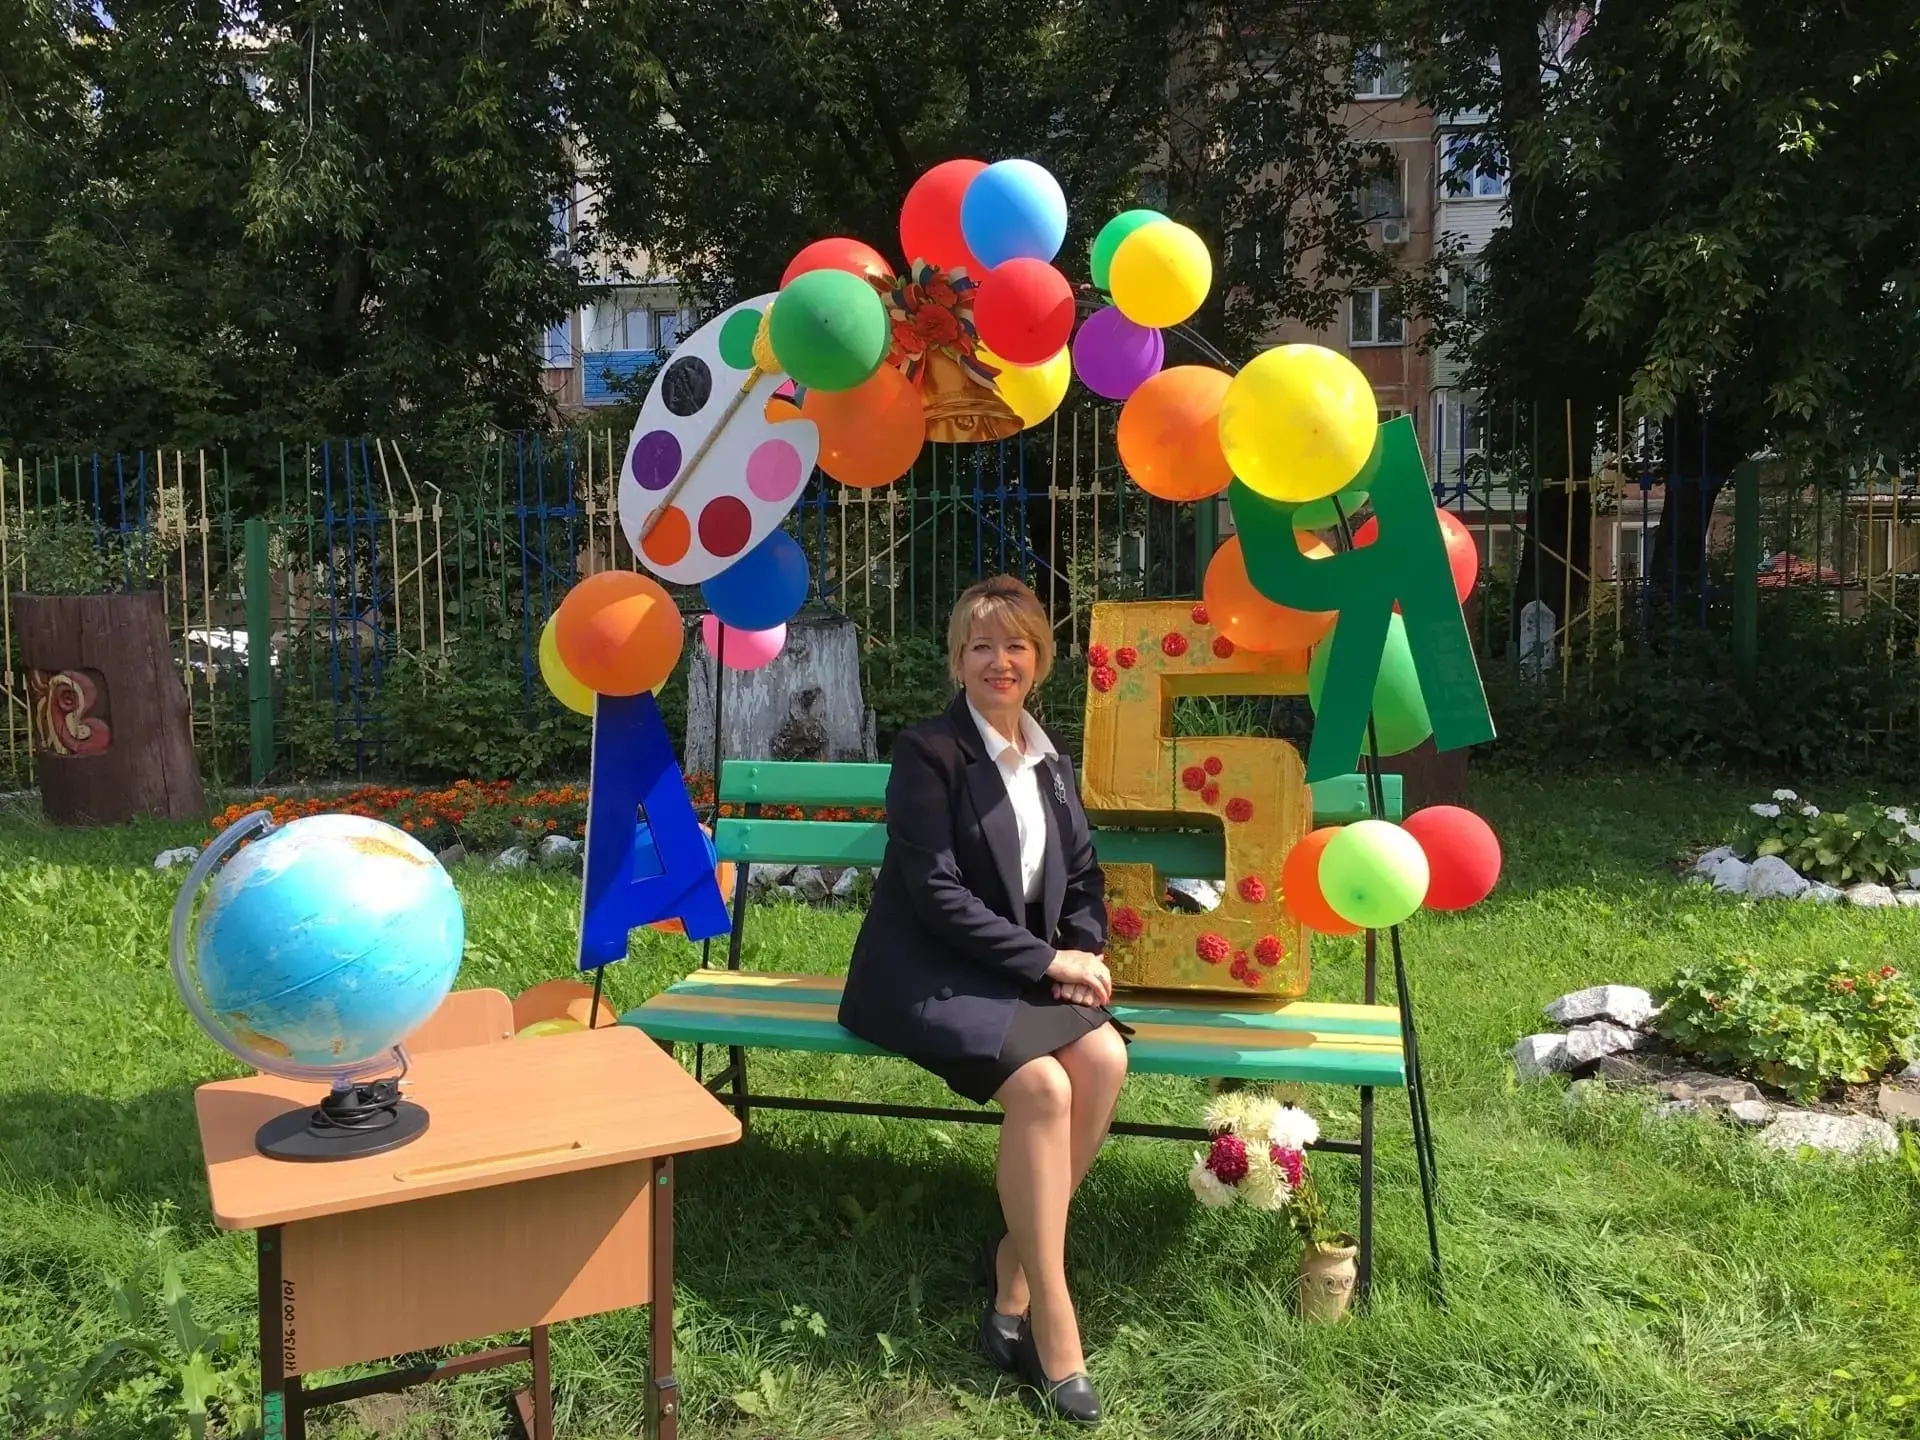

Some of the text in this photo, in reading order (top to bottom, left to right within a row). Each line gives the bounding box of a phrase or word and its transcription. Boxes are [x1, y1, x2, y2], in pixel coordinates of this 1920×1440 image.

[1228, 414, 1496, 784] Я
[577, 690, 732, 971] А
[1081, 601, 1312, 997] 5
